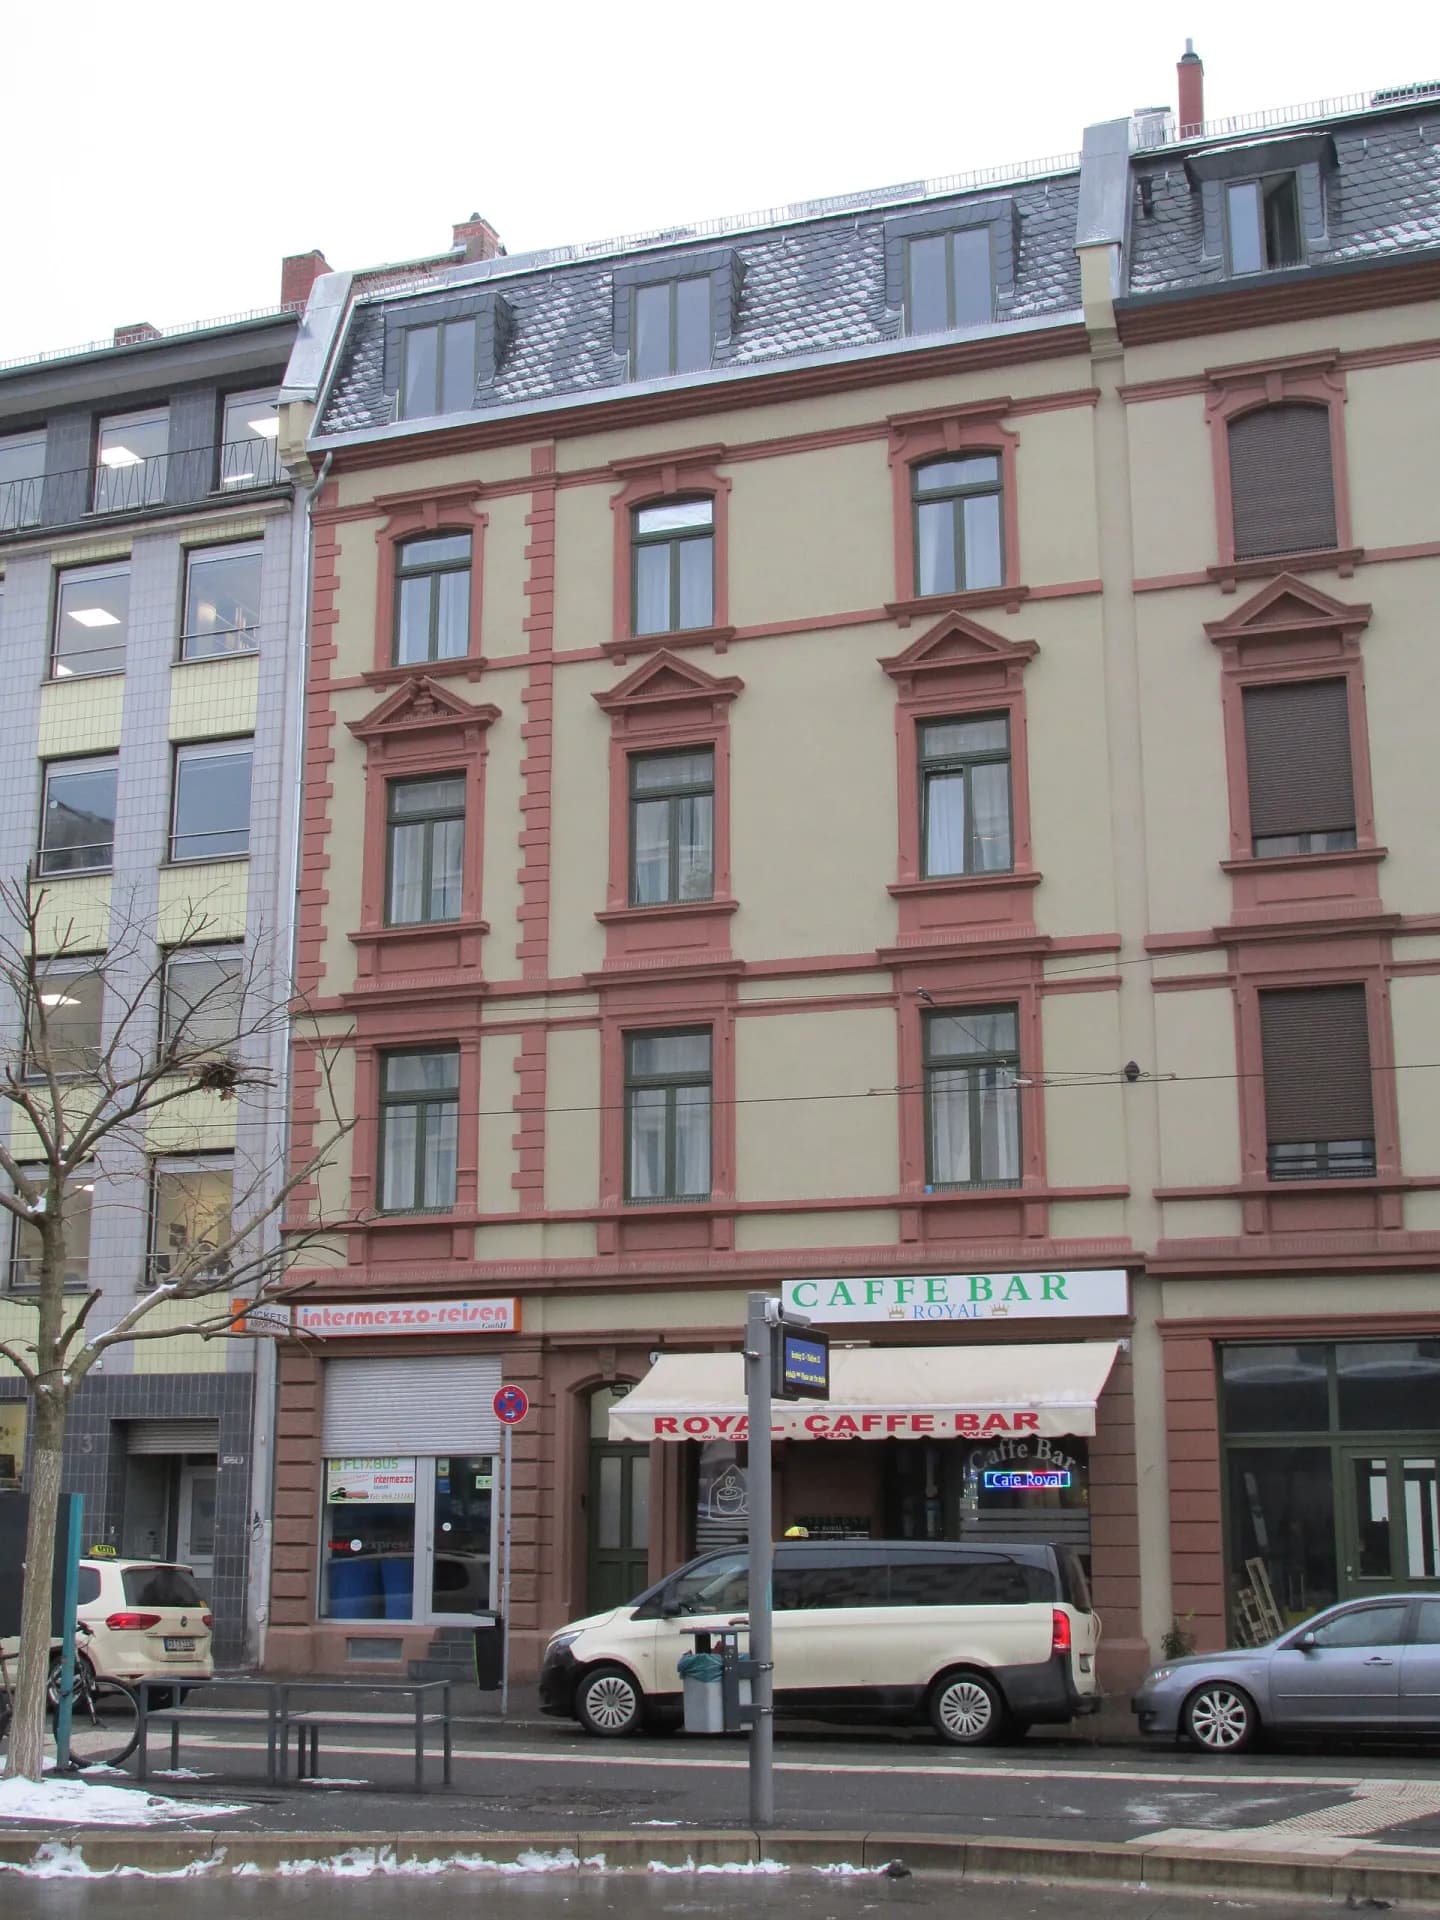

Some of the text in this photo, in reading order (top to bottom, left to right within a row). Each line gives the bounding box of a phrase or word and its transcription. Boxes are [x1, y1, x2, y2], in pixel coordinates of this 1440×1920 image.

[792, 1274, 1069, 1307] CAFFE BAR
[302, 1303, 508, 1327] intermezzo-reisen
[913, 1303, 983, 1319] ROYAL
[804, 1414, 935, 1433] CAFFE
[955, 1412, 1041, 1431] BAR
[81, 1433, 93, 1453] 3
[343, 1457, 399, 1471] FLIXBUS
[968, 1438, 1077, 1472] Caffe Bar
[373, 1475, 414, 1484] intermezzo
[992, 1473, 1022, 1487] Cafe
